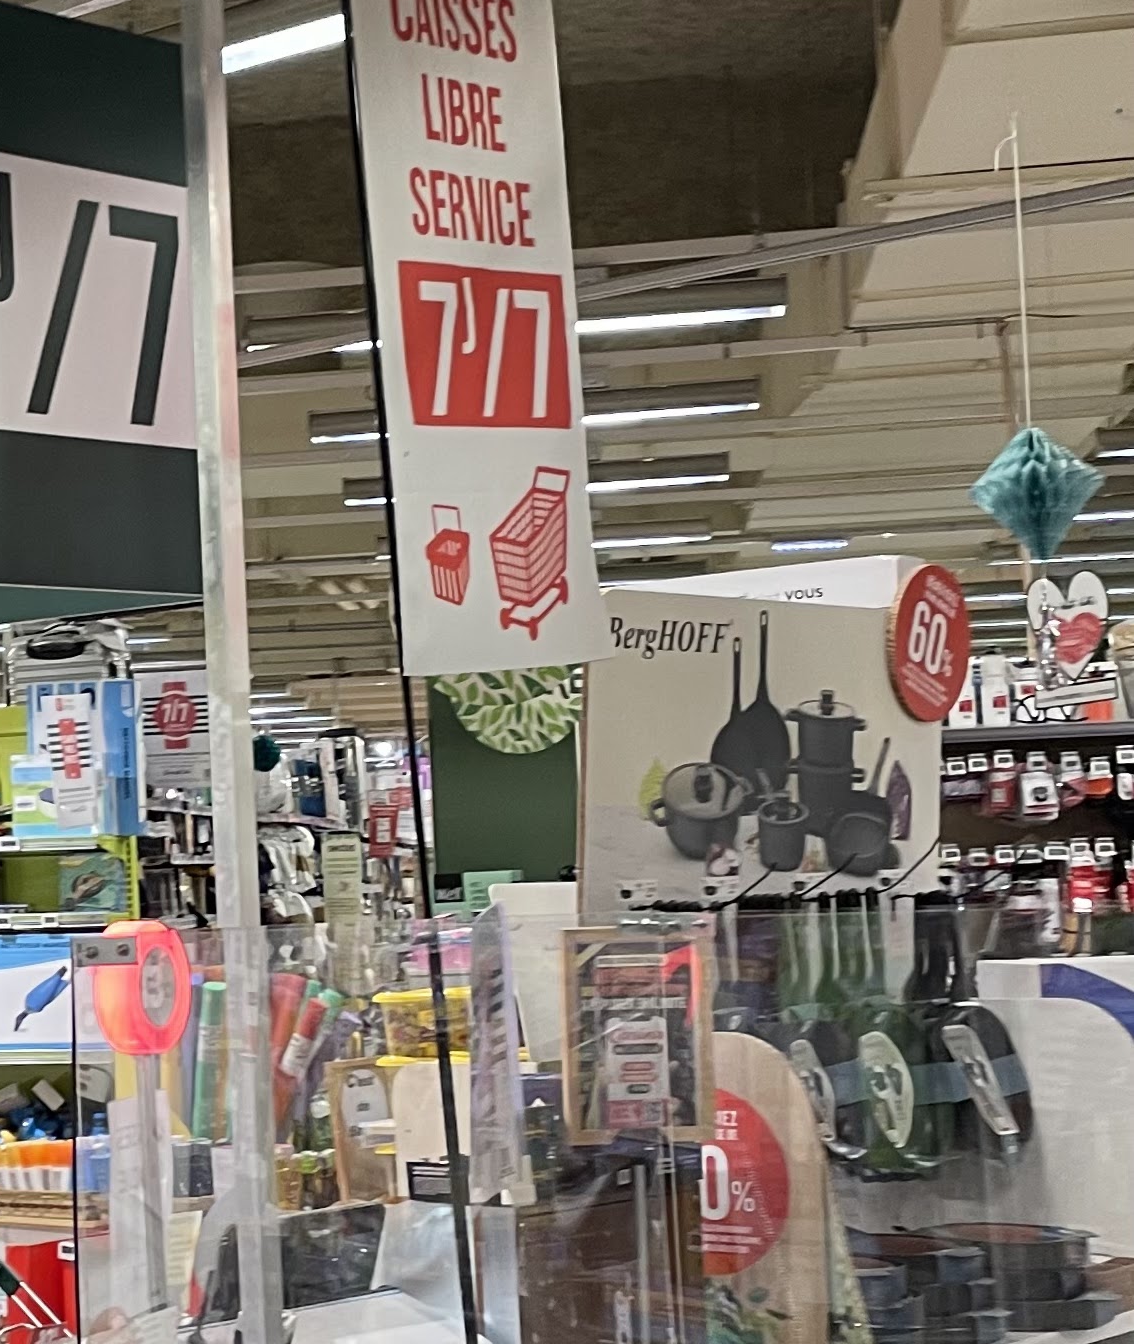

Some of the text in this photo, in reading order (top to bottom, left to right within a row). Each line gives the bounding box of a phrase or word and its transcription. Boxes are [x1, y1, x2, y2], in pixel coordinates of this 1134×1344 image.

[421, 72, 507, 153] LIBRE
[409, 167, 536, 249] SERVICE
[785, 587, 824, 601] VOUS
[610, 617, 731, 660] BergHOFF
